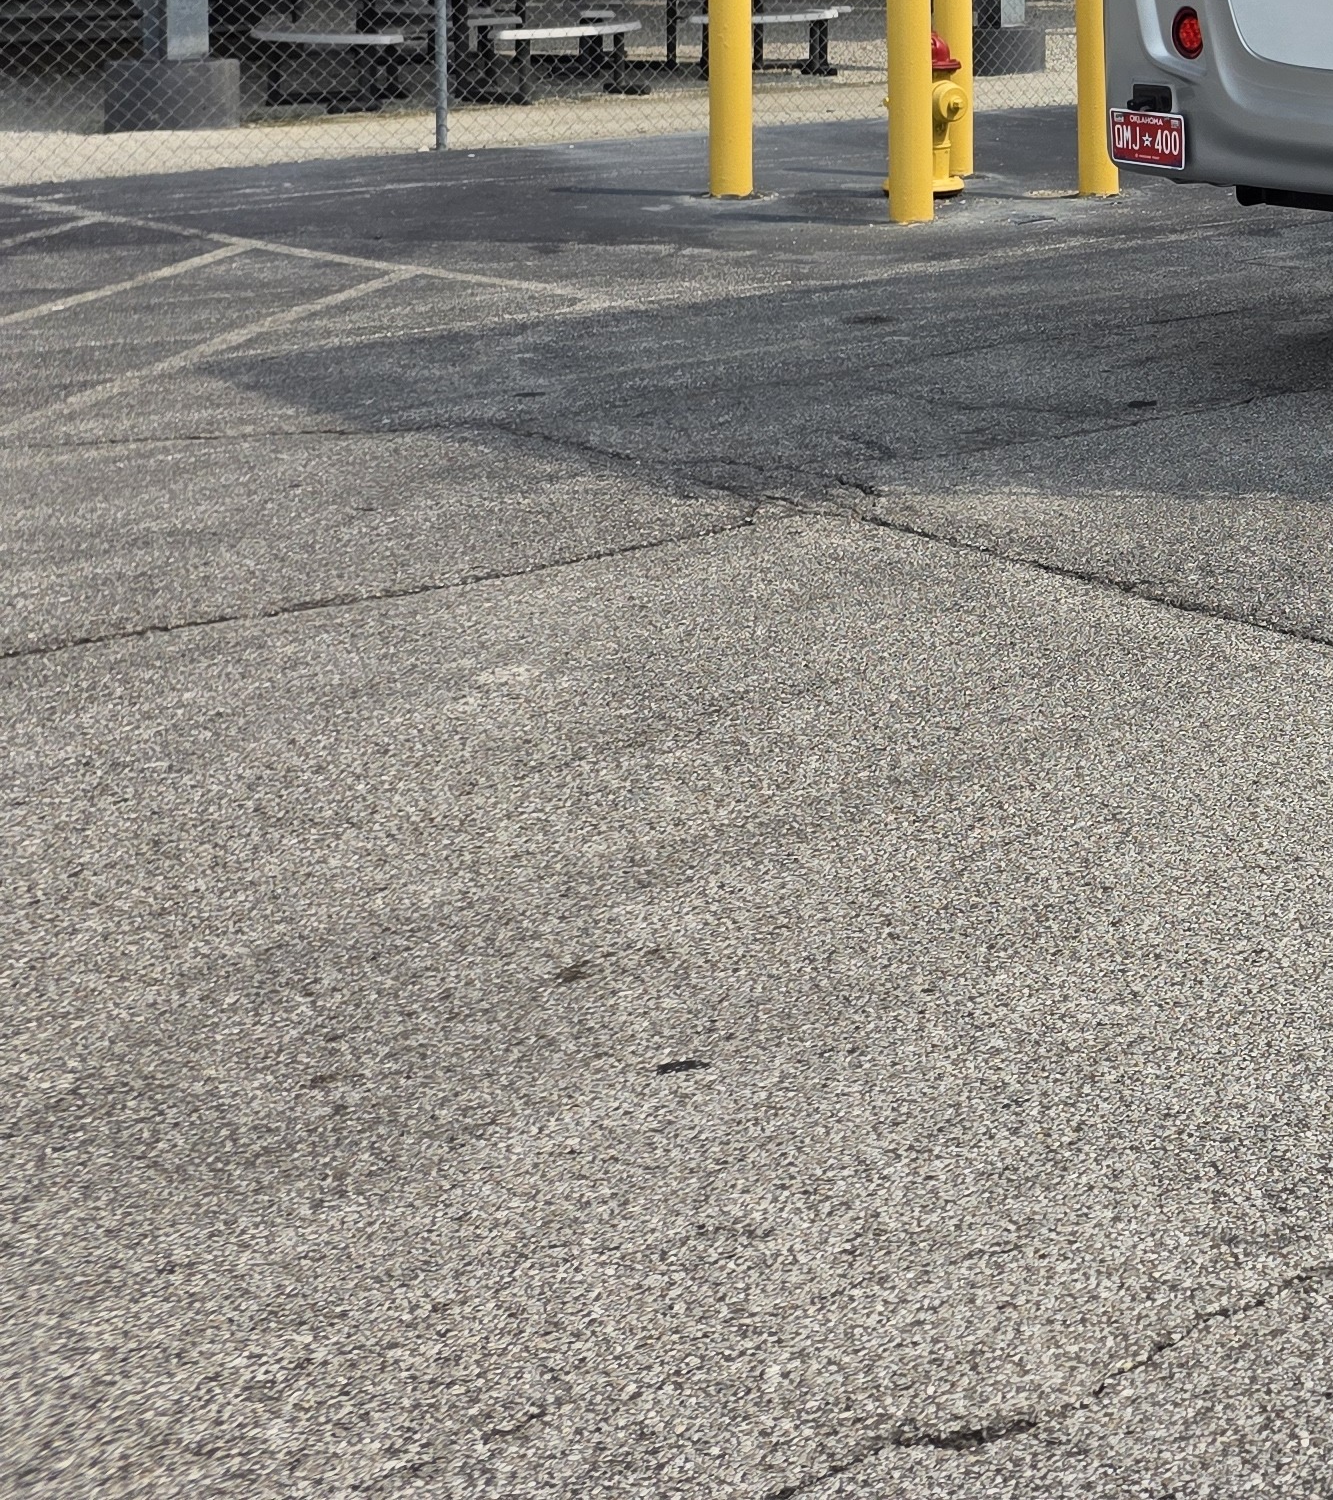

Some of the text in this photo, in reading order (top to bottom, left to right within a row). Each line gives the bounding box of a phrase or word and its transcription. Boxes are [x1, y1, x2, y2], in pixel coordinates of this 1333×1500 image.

[1129, 114, 1164, 126] OKLAHOMA
[1114, 124, 1180, 156] QMJ 400
